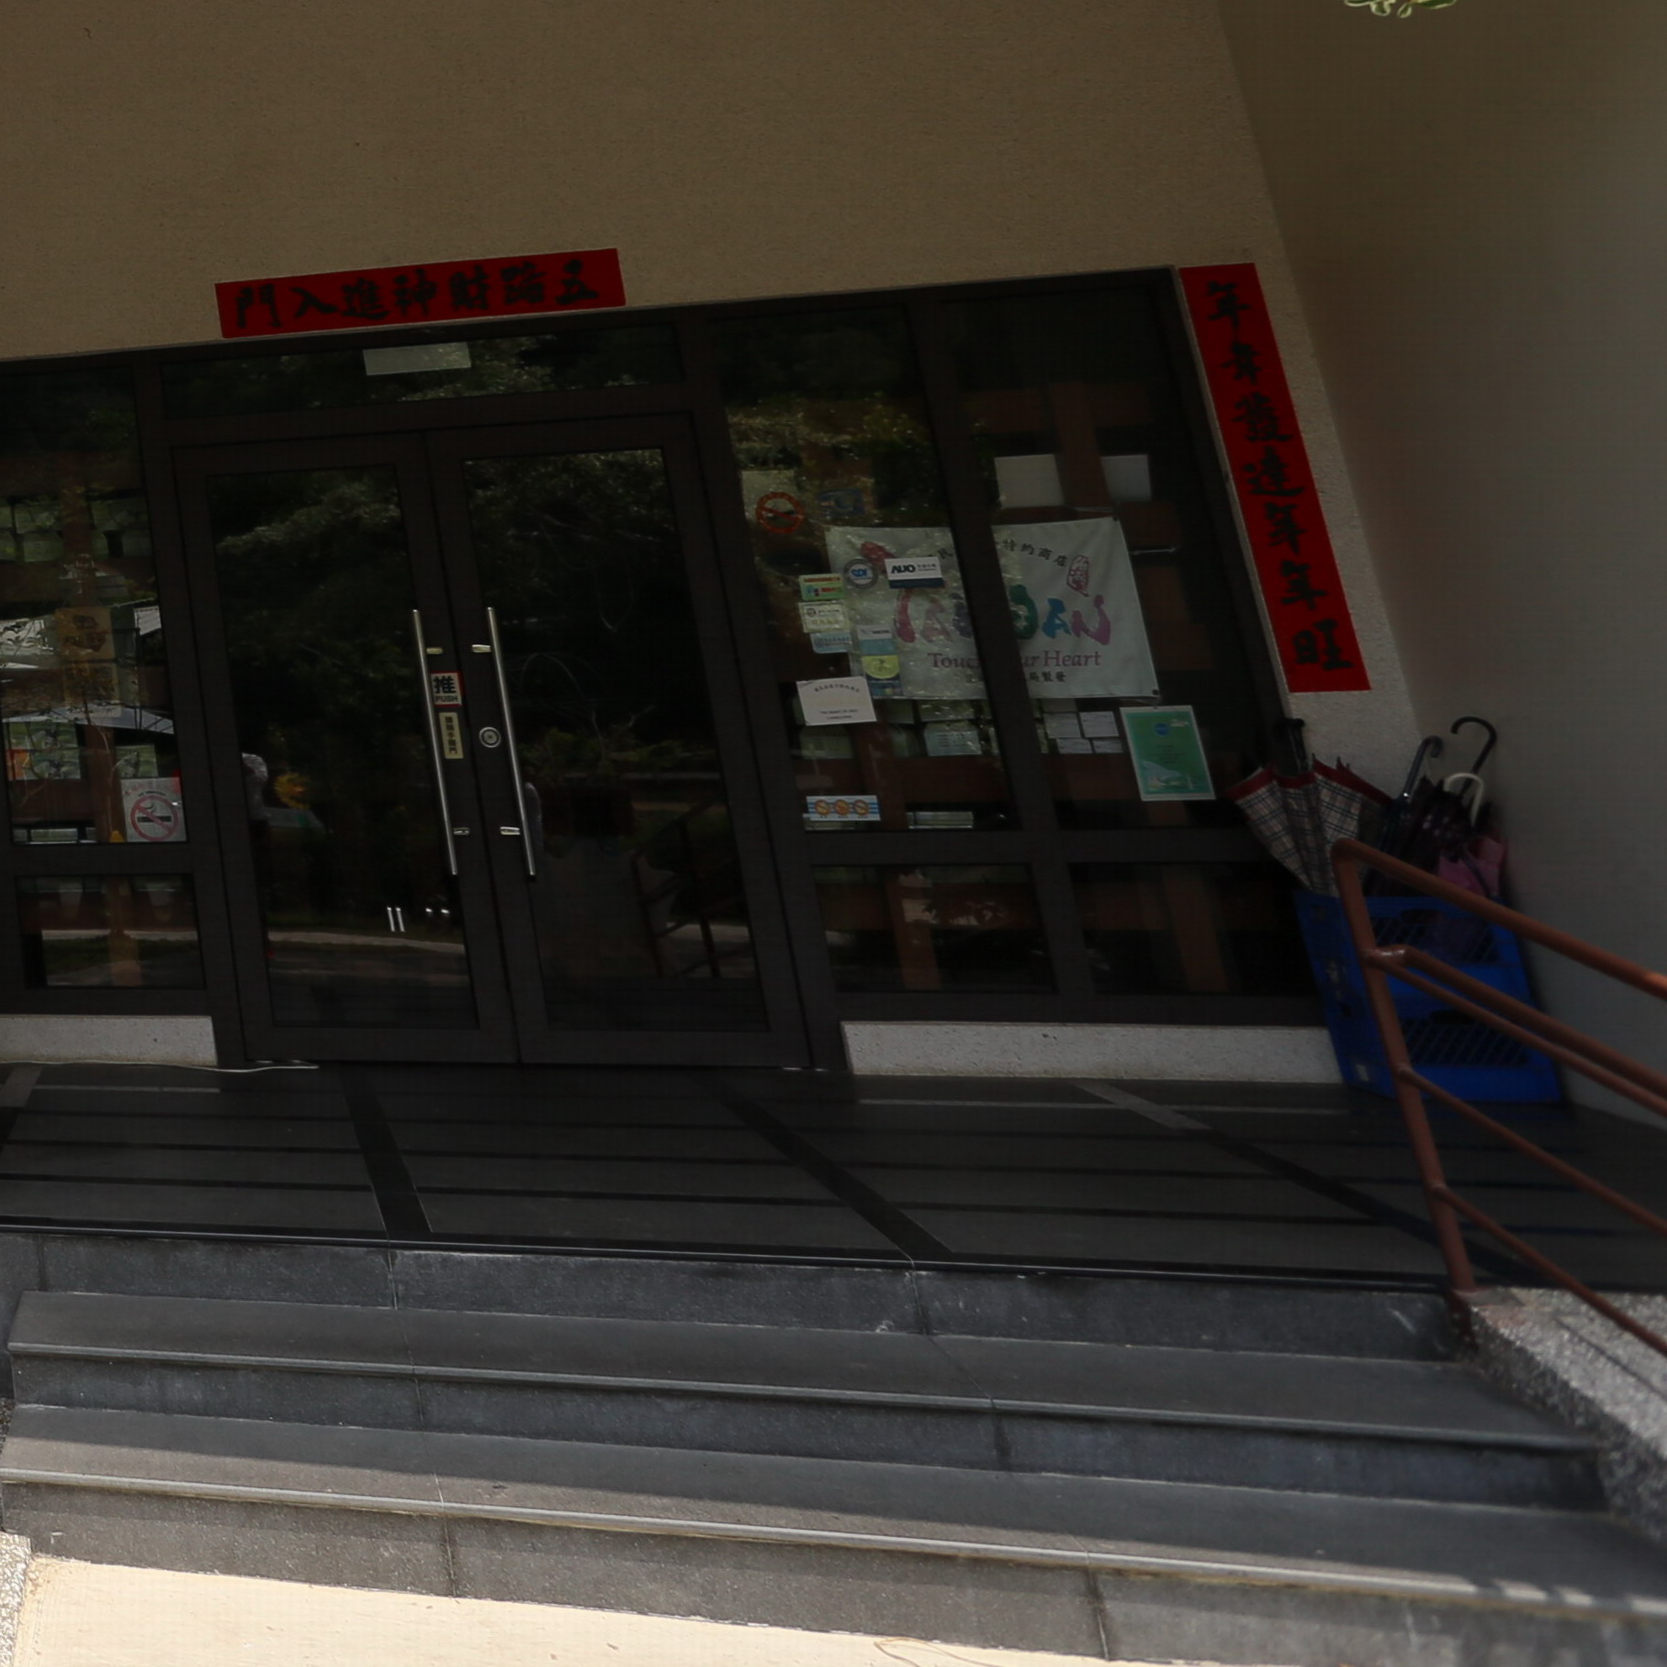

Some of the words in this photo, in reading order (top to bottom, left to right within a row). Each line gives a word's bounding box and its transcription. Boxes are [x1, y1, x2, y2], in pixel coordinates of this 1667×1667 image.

[1205, 280, 1354, 671] 年年發達年年旺
[927, 651, 981, 669] Touc
[1043, 649, 1103, 667] Heart
[433, 675, 456, 694] 推
[435, 695, 458, 703] PUSH
